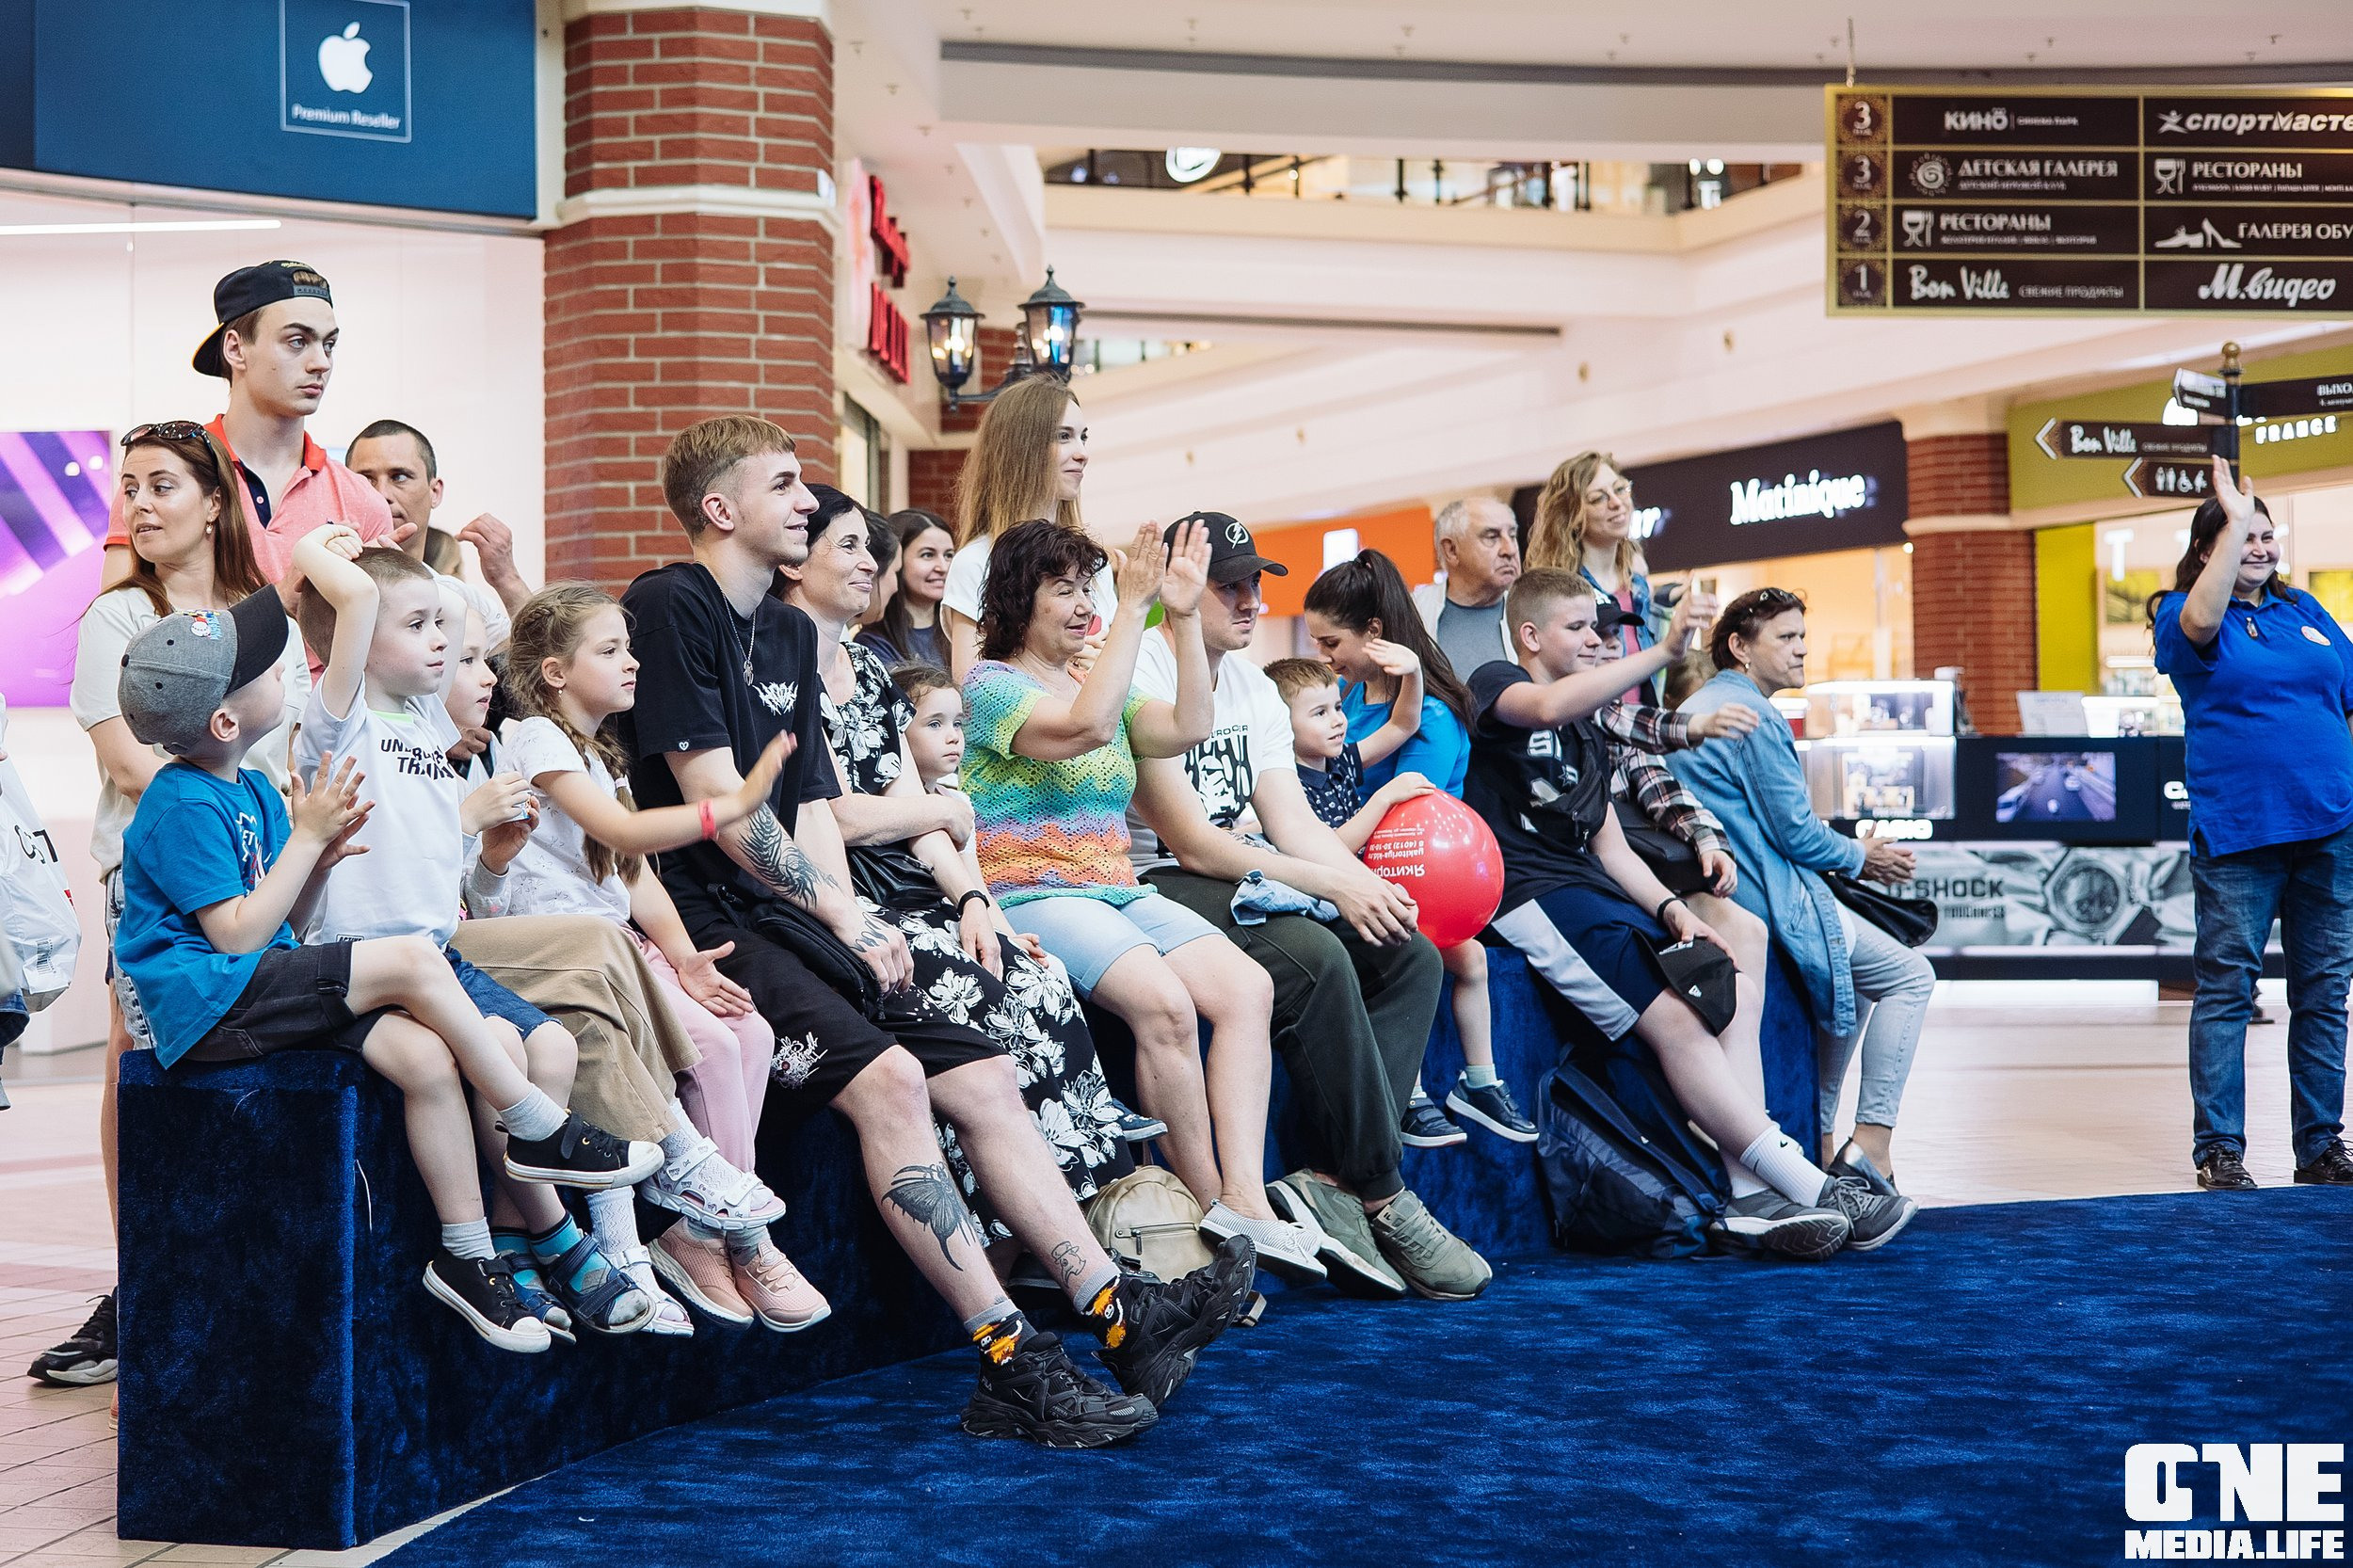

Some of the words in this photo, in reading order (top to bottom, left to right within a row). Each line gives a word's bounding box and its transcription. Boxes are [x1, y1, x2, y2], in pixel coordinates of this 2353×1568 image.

[292, 103, 350, 124] Premium
[350, 109, 400, 130] Reseller
[1853, 101, 1871, 130] 3
[1944, 108, 2009, 131] КИНО
[1853, 154, 1871, 184] 3
[1958, 159, 2041, 177] ДЕТСКАЯ
[2044, 159, 2119, 177] ГАЛЕРЕЯ
[2192, 161, 2303, 178] РЕСТОРАНЫ
[1853, 210, 1871, 237] 2
[1940, 213, 2052, 232] РЕСТОРАНЫ
[2237, 222, 2312, 239] ГАЛЕРЕЯ
[1855, 264, 1868, 291] 1
[1908, 264, 1957, 300] Bon
[1960, 264, 2010, 300] Ville
[2316, 382, 2353, 396] ВЫХО
[2070, 424, 2102, 454] Bon
[2103, 425, 2137, 454] Ville
[2255, 415, 2337, 444] FRANCE
[1730, 469, 1865, 525] Matinique
